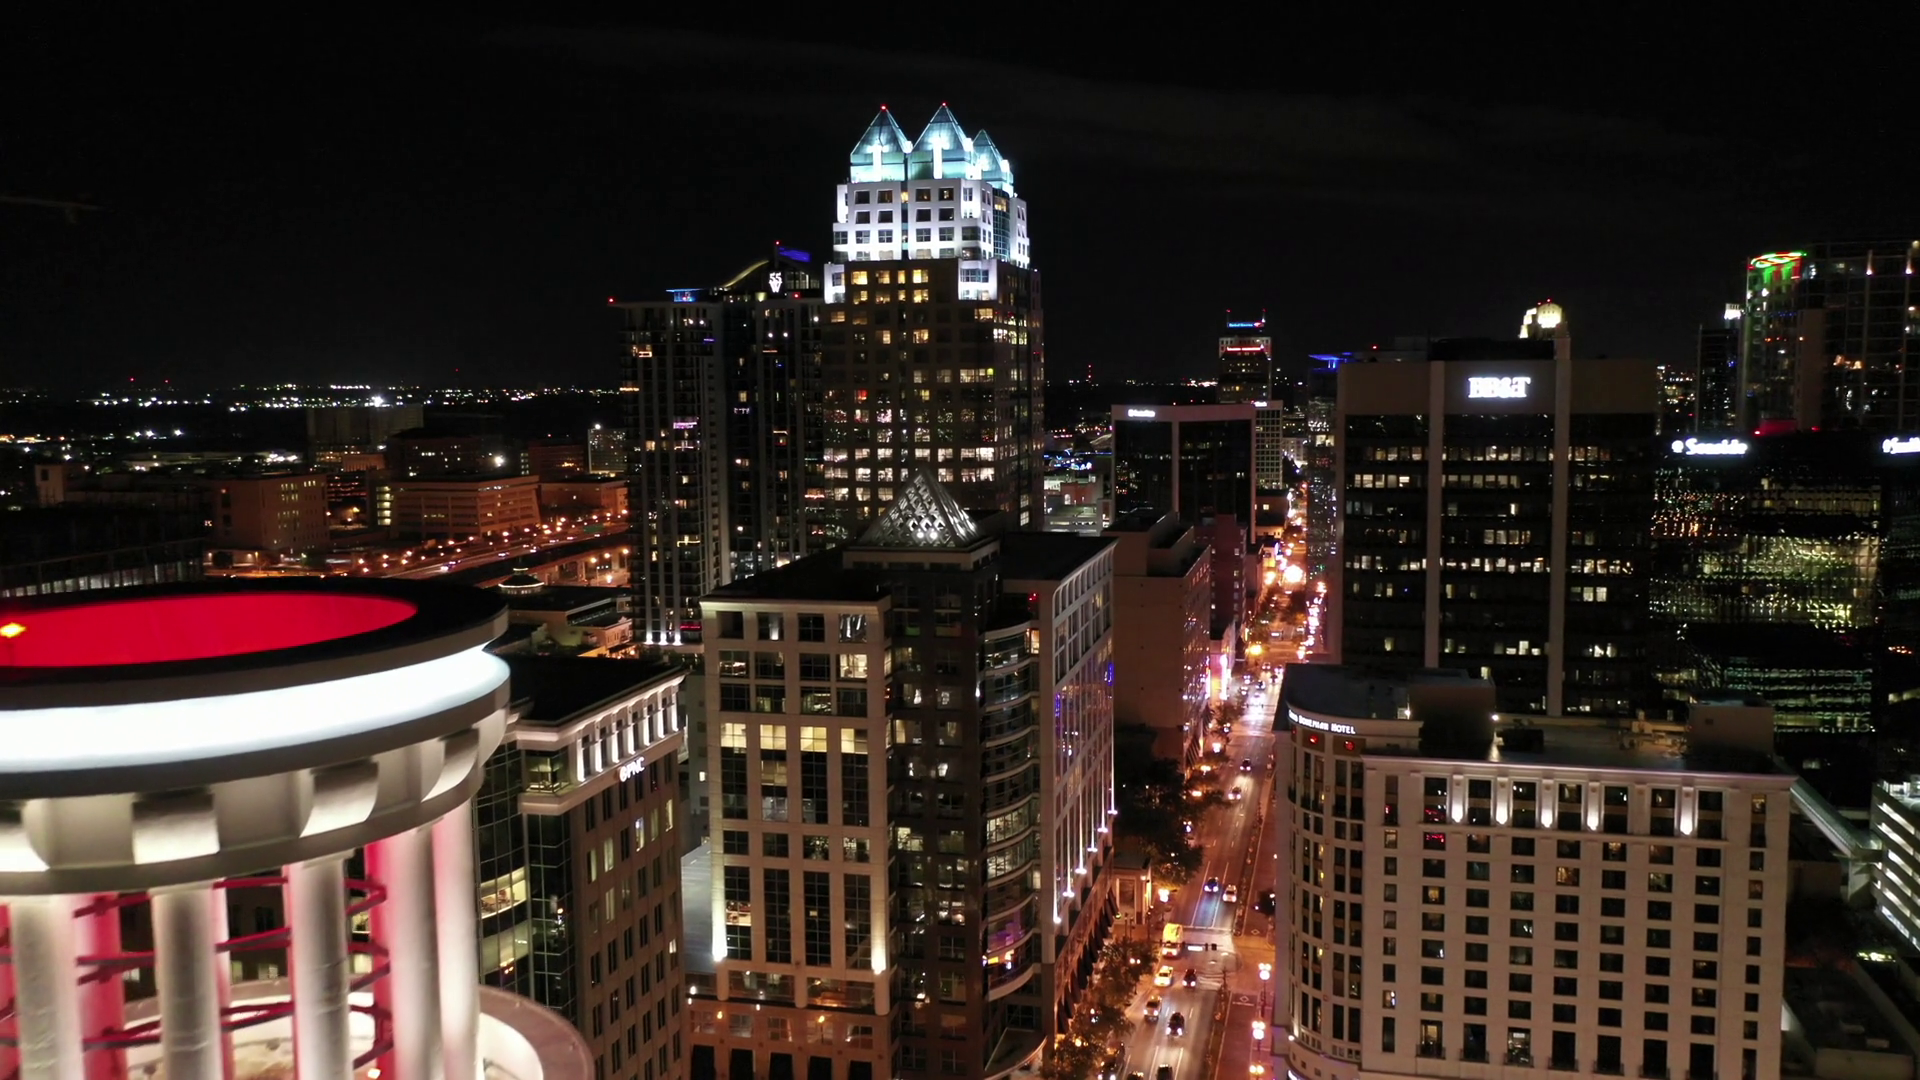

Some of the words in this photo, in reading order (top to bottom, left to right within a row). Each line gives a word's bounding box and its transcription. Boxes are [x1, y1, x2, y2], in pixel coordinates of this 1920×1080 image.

[769, 272, 782, 282] 55
[1468, 376, 1531, 398] BB&T
[1331, 723, 1356, 735] HOTEL
[626, 757, 645, 778] PNC
